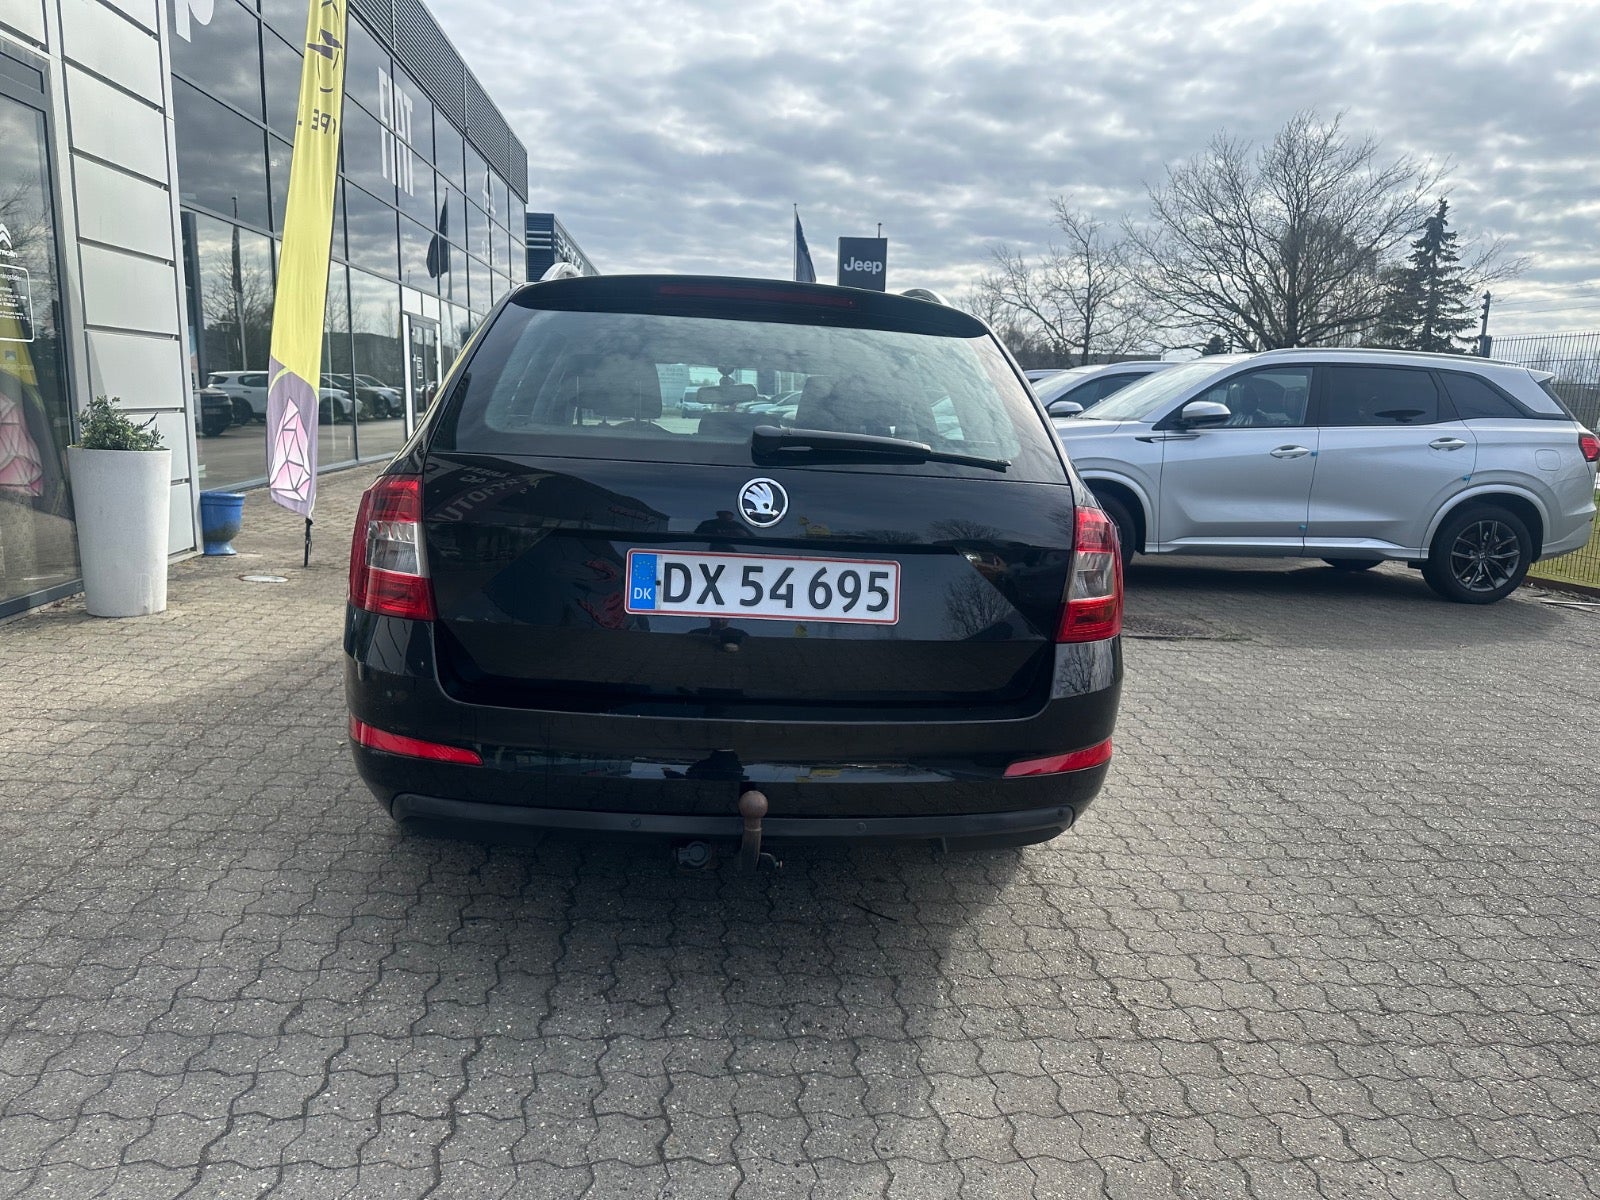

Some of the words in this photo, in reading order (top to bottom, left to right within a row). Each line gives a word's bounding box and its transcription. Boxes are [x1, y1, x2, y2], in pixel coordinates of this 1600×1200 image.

[378, 66, 414, 197] FIAT
[843, 256, 883, 275] Jeep
[633, 587, 652, 600] DK
[662, 562, 726, 606] DX
[739, 565, 795, 609] 54
[808, 566, 890, 613] 695
